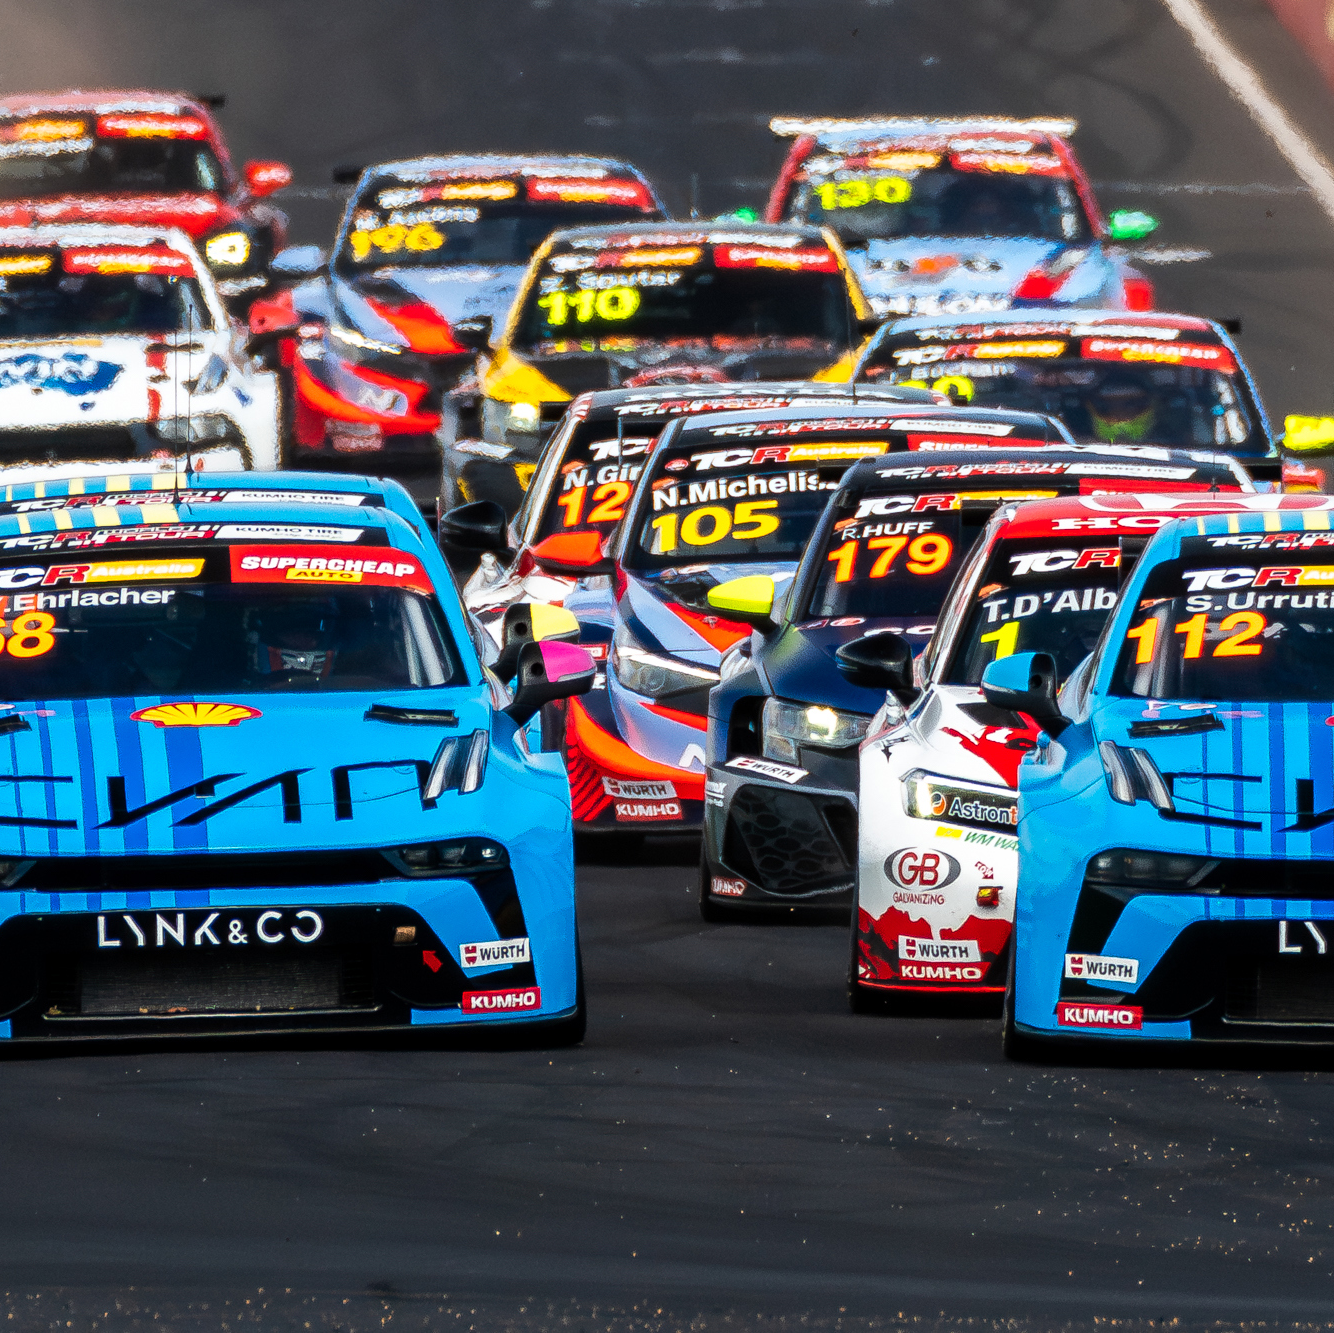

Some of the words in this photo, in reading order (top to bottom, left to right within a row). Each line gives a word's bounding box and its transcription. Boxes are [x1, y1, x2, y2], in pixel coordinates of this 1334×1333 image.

[537, 285, 641, 326] 110
[690, 445, 793, 472] TCR
[853, 493, 961, 520] TCR
[234, 526, 296, 536] KUMHO
[301, 528, 344, 537] TIRE
[650, 499, 781, 555] 105
[841, 520, 936, 542] R.HUFF
[239, 555, 416, 579] SUPERCHEAP
[827, 532, 954, 585] 179
[1008, 547, 1122, 577] TCR
[91, 563, 196, 577] Australia
[295, 569, 355, 580] AUTO
[1181, 566, 1305, 592] TCR
[980, 621, 1021, 662] 1
[1126, 611, 1268, 665] 112
[752, 759, 795, 779] WÜRTH
[621, 782, 668, 797] WÜRTH
[616, 803, 680, 818] KUMHO
[964, 831, 993, 848] WM
[897, 850, 942, 887] GB
[892, 890, 945, 906] GALVANIZING
[479, 943, 526, 962] WÜRTH
[918, 942, 969, 959] WÜRTH
[901, 965, 983, 981] KUMHO
[1085, 959, 1134, 979] WÜRTH
[470, 992, 536, 1010] KUMHO
[1064, 1008, 1134, 1025] KUMHO
